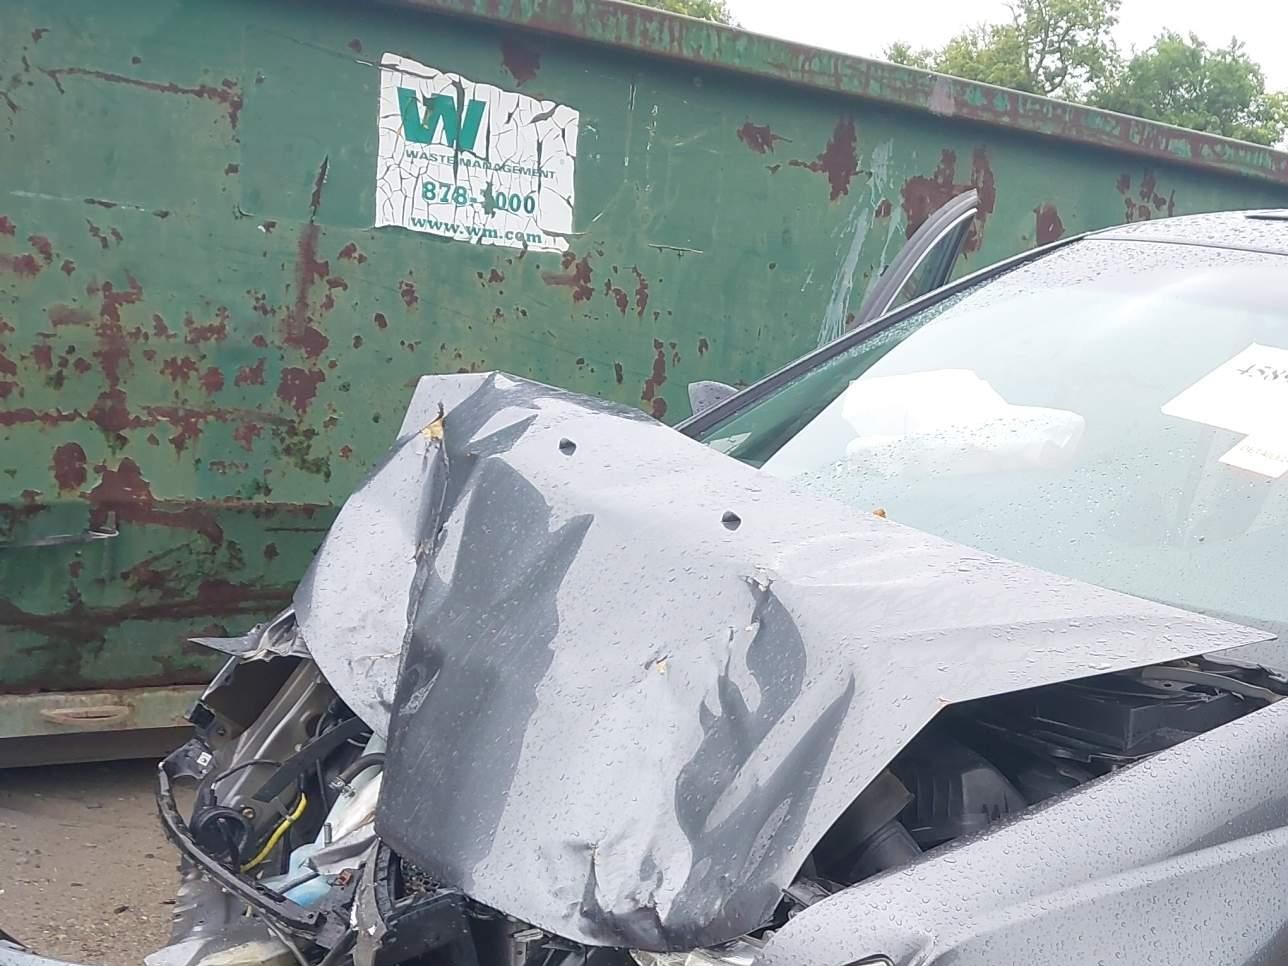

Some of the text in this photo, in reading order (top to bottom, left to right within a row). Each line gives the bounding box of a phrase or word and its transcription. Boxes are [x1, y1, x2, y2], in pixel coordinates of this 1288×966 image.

[405, 149, 556, 179] WASTE MANAGEMENT
[421, 180, 536, 214] 878-000
[410, 217, 543, 244] www.wm.com
